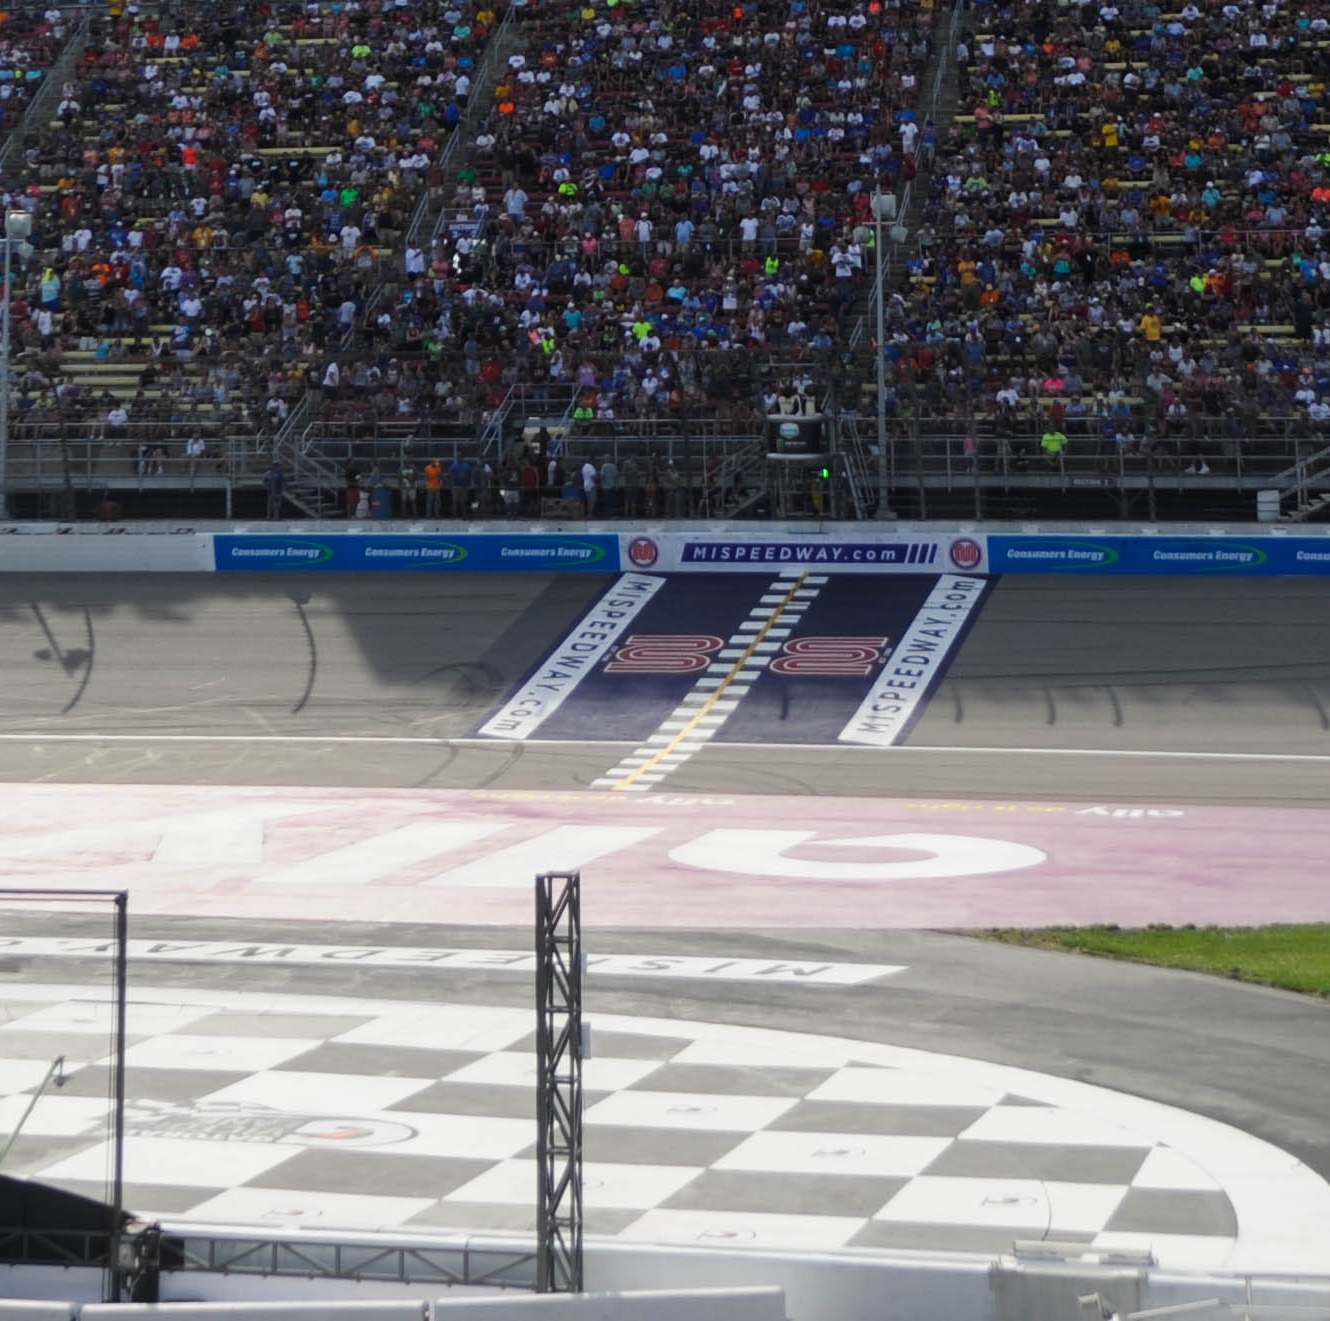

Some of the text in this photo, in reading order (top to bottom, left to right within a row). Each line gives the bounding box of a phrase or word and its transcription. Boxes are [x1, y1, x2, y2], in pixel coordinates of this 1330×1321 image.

[231, 547, 320, 558] Consumers Energy
[365, 547, 455, 559] Consumers Energy
[501, 547, 592, 558] Consumers Energy
[694, 546, 897, 560] MISPEEDWAY.com
[1007, 548, 1104, 560] Consumers Energy
[1153, 550, 1253, 562] Consumers Energy
[492, 579, 653, 733] MISPEEDWAY.com
[856, 580, 977, 734] MISPEEDWAY.com
[1074, 806, 1186, 818] ally
